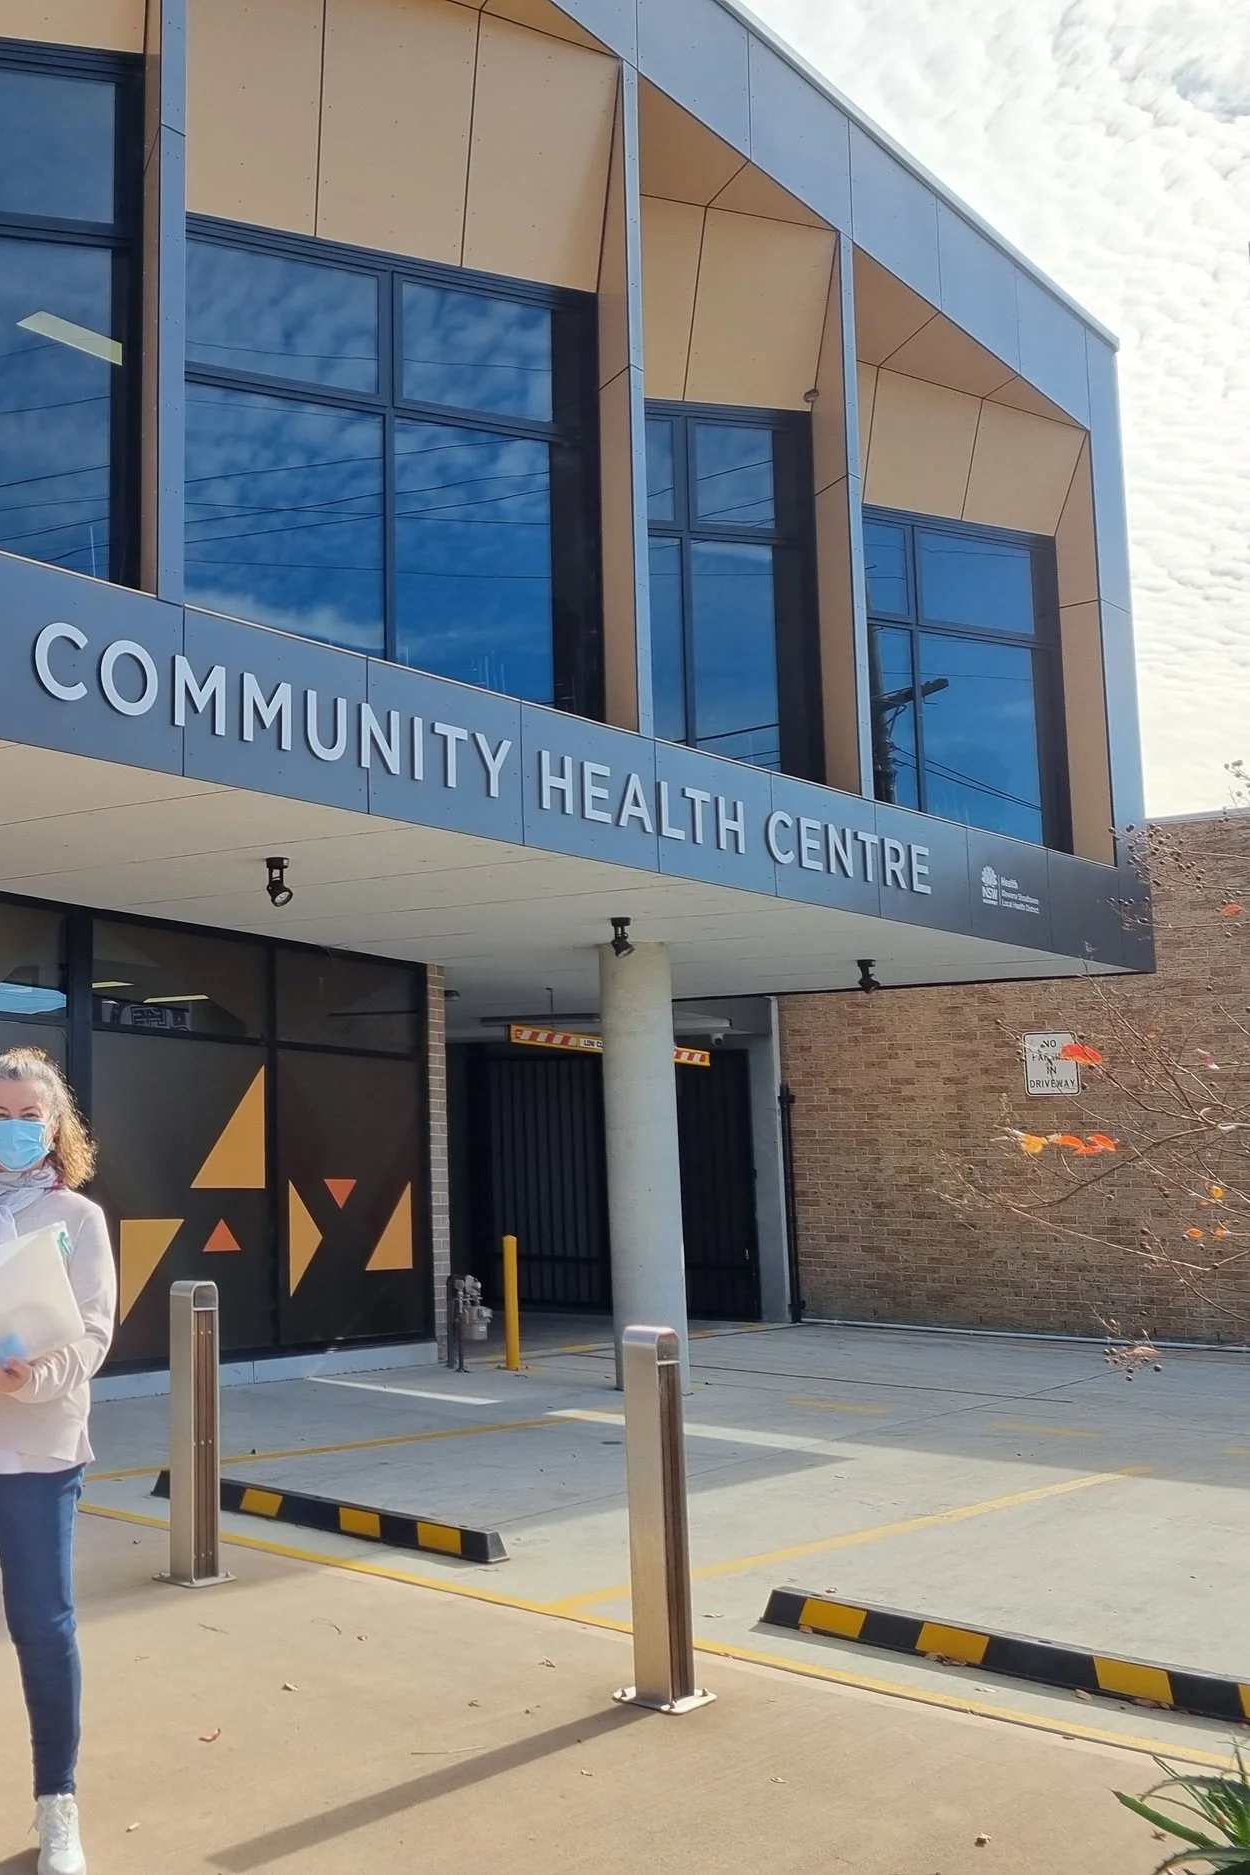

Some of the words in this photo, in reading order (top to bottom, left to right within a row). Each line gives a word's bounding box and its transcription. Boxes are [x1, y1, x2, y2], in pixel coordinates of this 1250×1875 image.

[33, 622, 512, 798] COMMUNITY
[538, 750, 746, 855] HEALTH
[766, 811, 932, 895] CENTRE
[982, 886, 998, 900] NSW
[1042, 1039, 1057, 1048] NO
[1046, 1066, 1057, 1074] IN
[1029, 1079, 1075, 1088] DRIVEWAY
